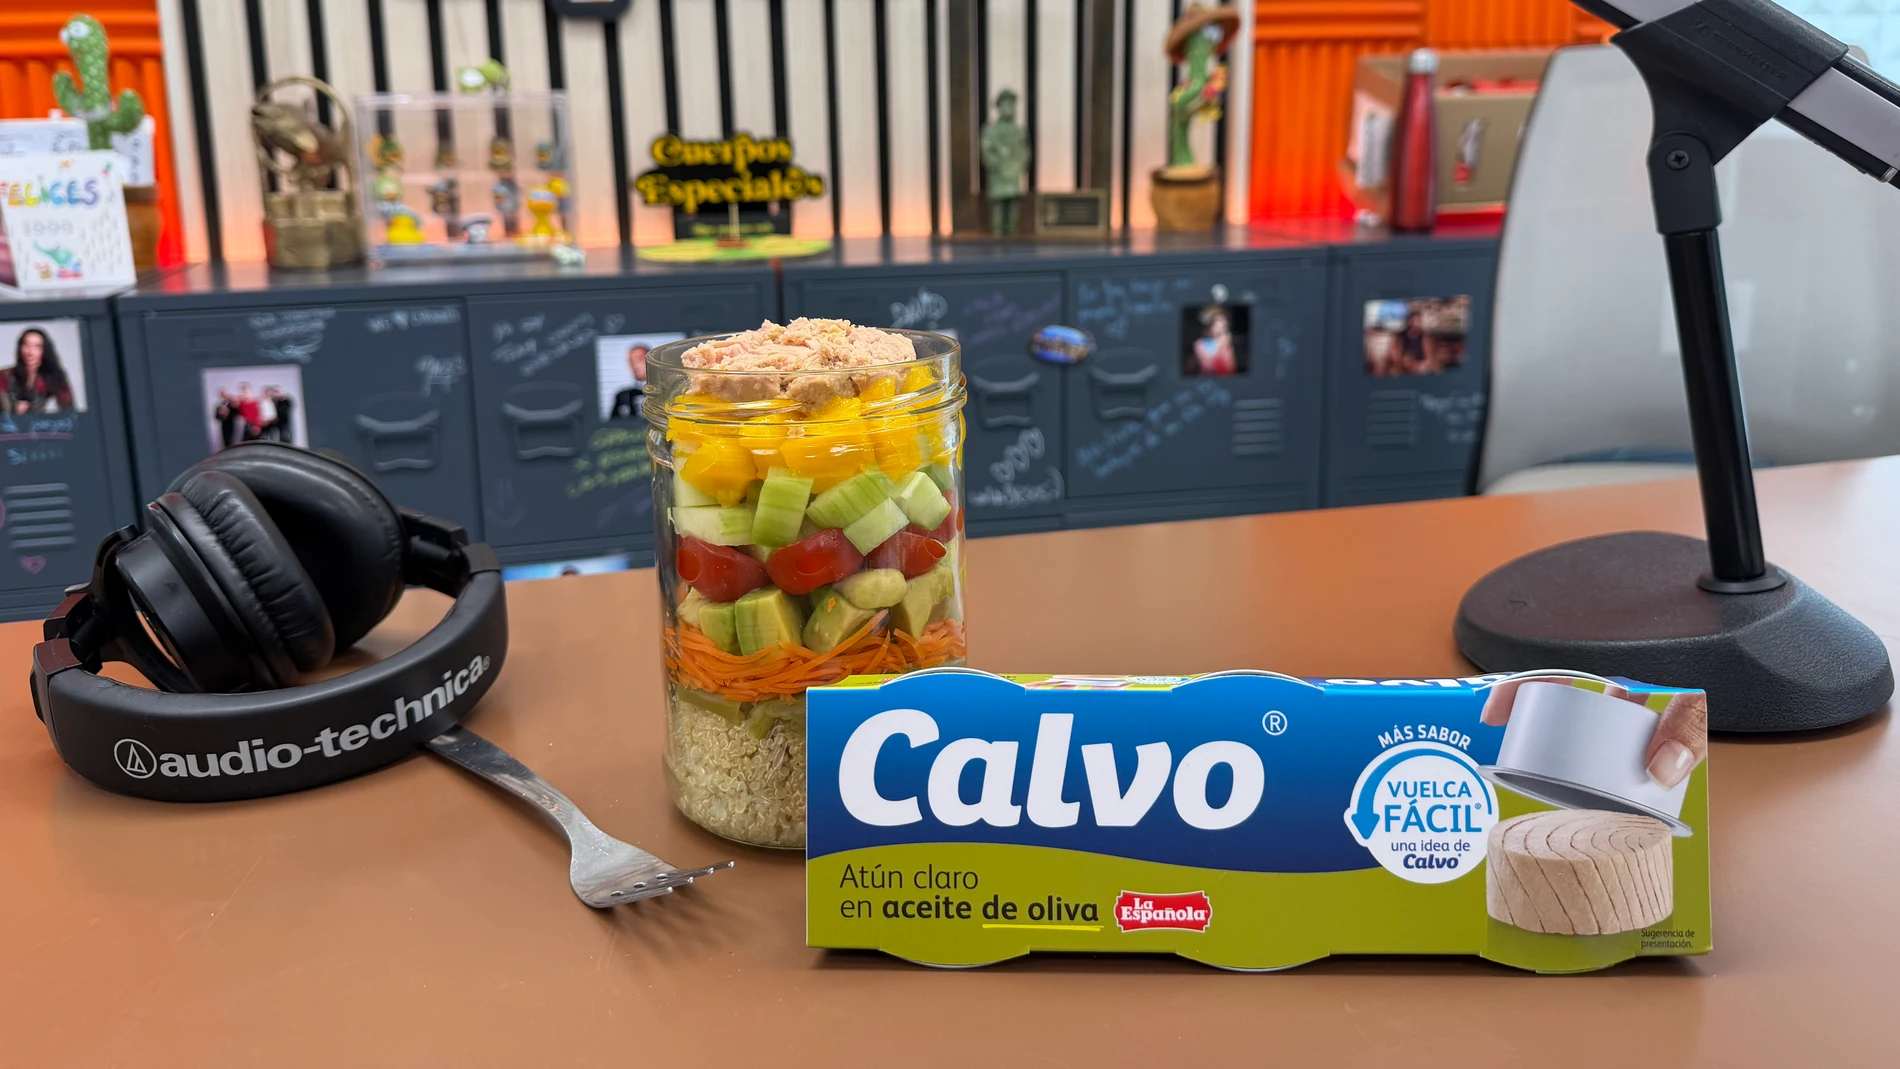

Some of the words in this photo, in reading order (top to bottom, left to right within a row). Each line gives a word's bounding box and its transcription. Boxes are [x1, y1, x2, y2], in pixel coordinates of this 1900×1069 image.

[652, 133, 792, 173] Cuerpos
[635, 167, 824, 214] Especiales
[1377, 724, 1414, 748] MÁS
[1417, 724, 1472, 750] SABOR
[1387, 781, 1472, 798] VUELCA
[1391, 842, 1417, 852] una
[1420, 839, 1450, 852] idea
[1453, 839, 1471, 852] de
[839, 863, 903, 889] Atún
[913, 864, 979, 890] claro
[841, 900, 872, 918] en
[882, 895, 972, 919] aceite
[982, 894, 1018, 920] de
[1028, 895, 1099, 922] oliva
[1134, 898, 1153, 910] La
[1121, 906, 1207, 924] Española
[1641, 928, 1684, 939] Sugerencia
[1685, 928, 1695, 938] de
[1641, 939, 1693, 949] presentación.
